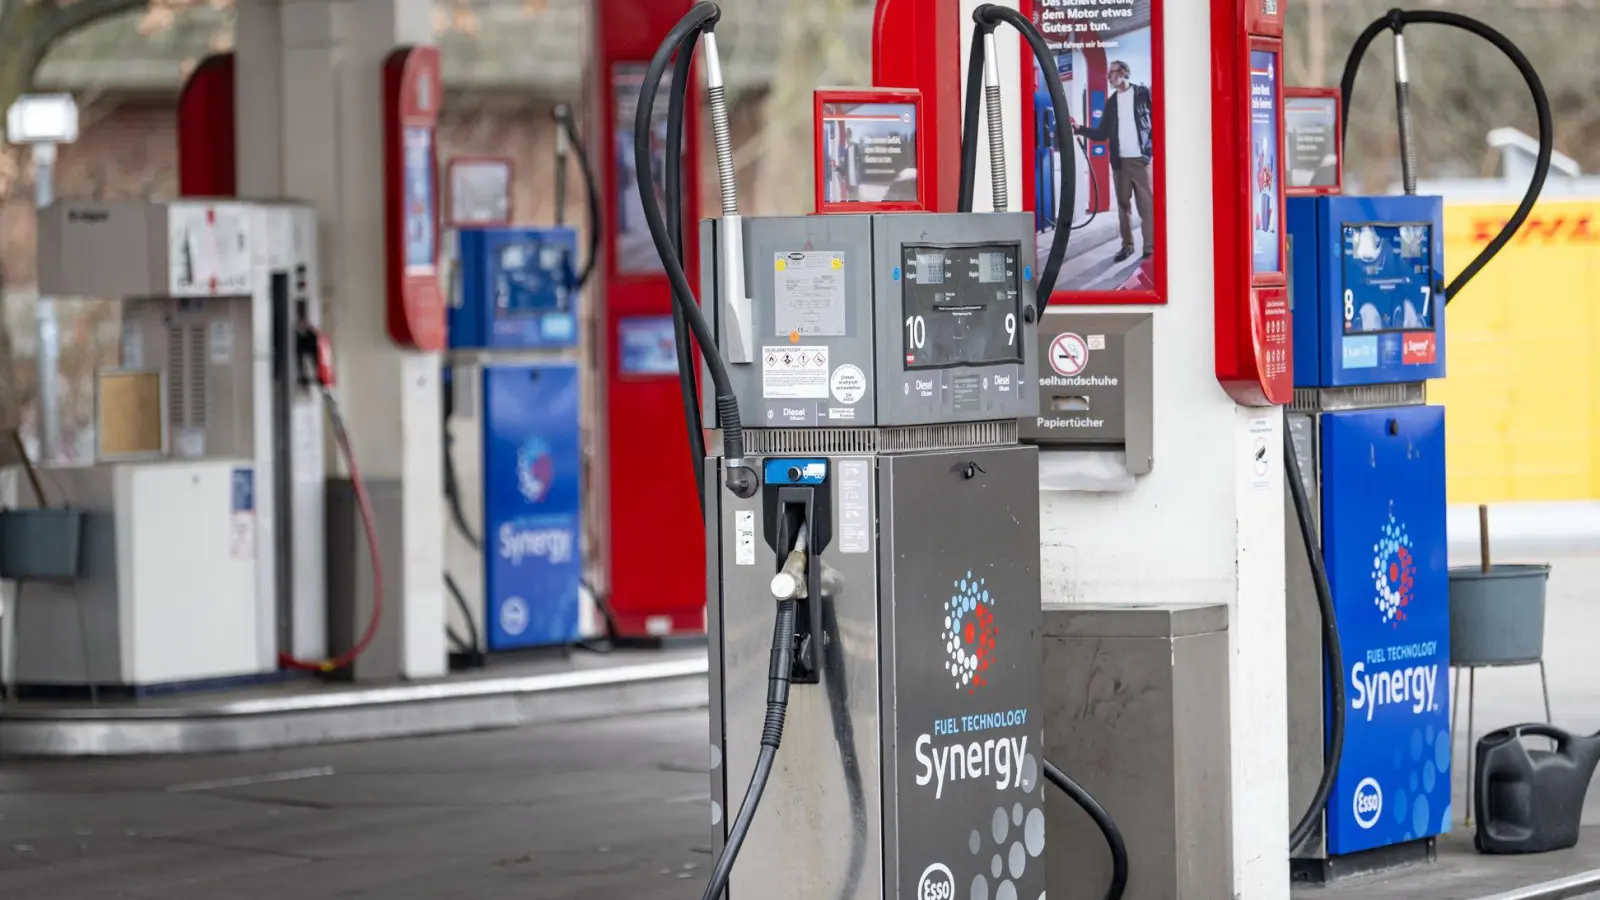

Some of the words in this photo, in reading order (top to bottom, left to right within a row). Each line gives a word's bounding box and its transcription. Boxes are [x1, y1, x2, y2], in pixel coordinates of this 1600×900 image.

[1042, 8, 1065, 20] dem
[1067, 8, 1099, 19] Motor
[1101, 8, 1133, 17] etwas
[1042, 22, 1073, 33] Gutes
[1075, 23, 1088, 32] zu
[1089, 22, 1111, 32] tun.
[1344, 289, 1355, 320] 8
[1420, 286, 1431, 317] 7
[905, 315, 926, 349] 10
[1004, 312, 1017, 346] 9
[915, 380, 933, 391] Diesel
[994, 374, 1010, 386] Diesel
[1039, 376, 1118, 386] selhandschuhe
[783, 407, 805, 416] Diesel
[1036, 417, 1105, 430] Papiertücher
[1366, 648, 1386, 664] FUEL
[1387, 640, 1438, 661] TECHNOLOGY
[1351, 661, 1438, 721] Synergy
[934, 717, 959, 736] FUEL
[961, 708, 1028, 732] TECHNOLOGY
[915, 733, 1028, 799] Synergy
[1358, 791, 1378, 813] Esso
[923, 878, 950, 900] Esso
